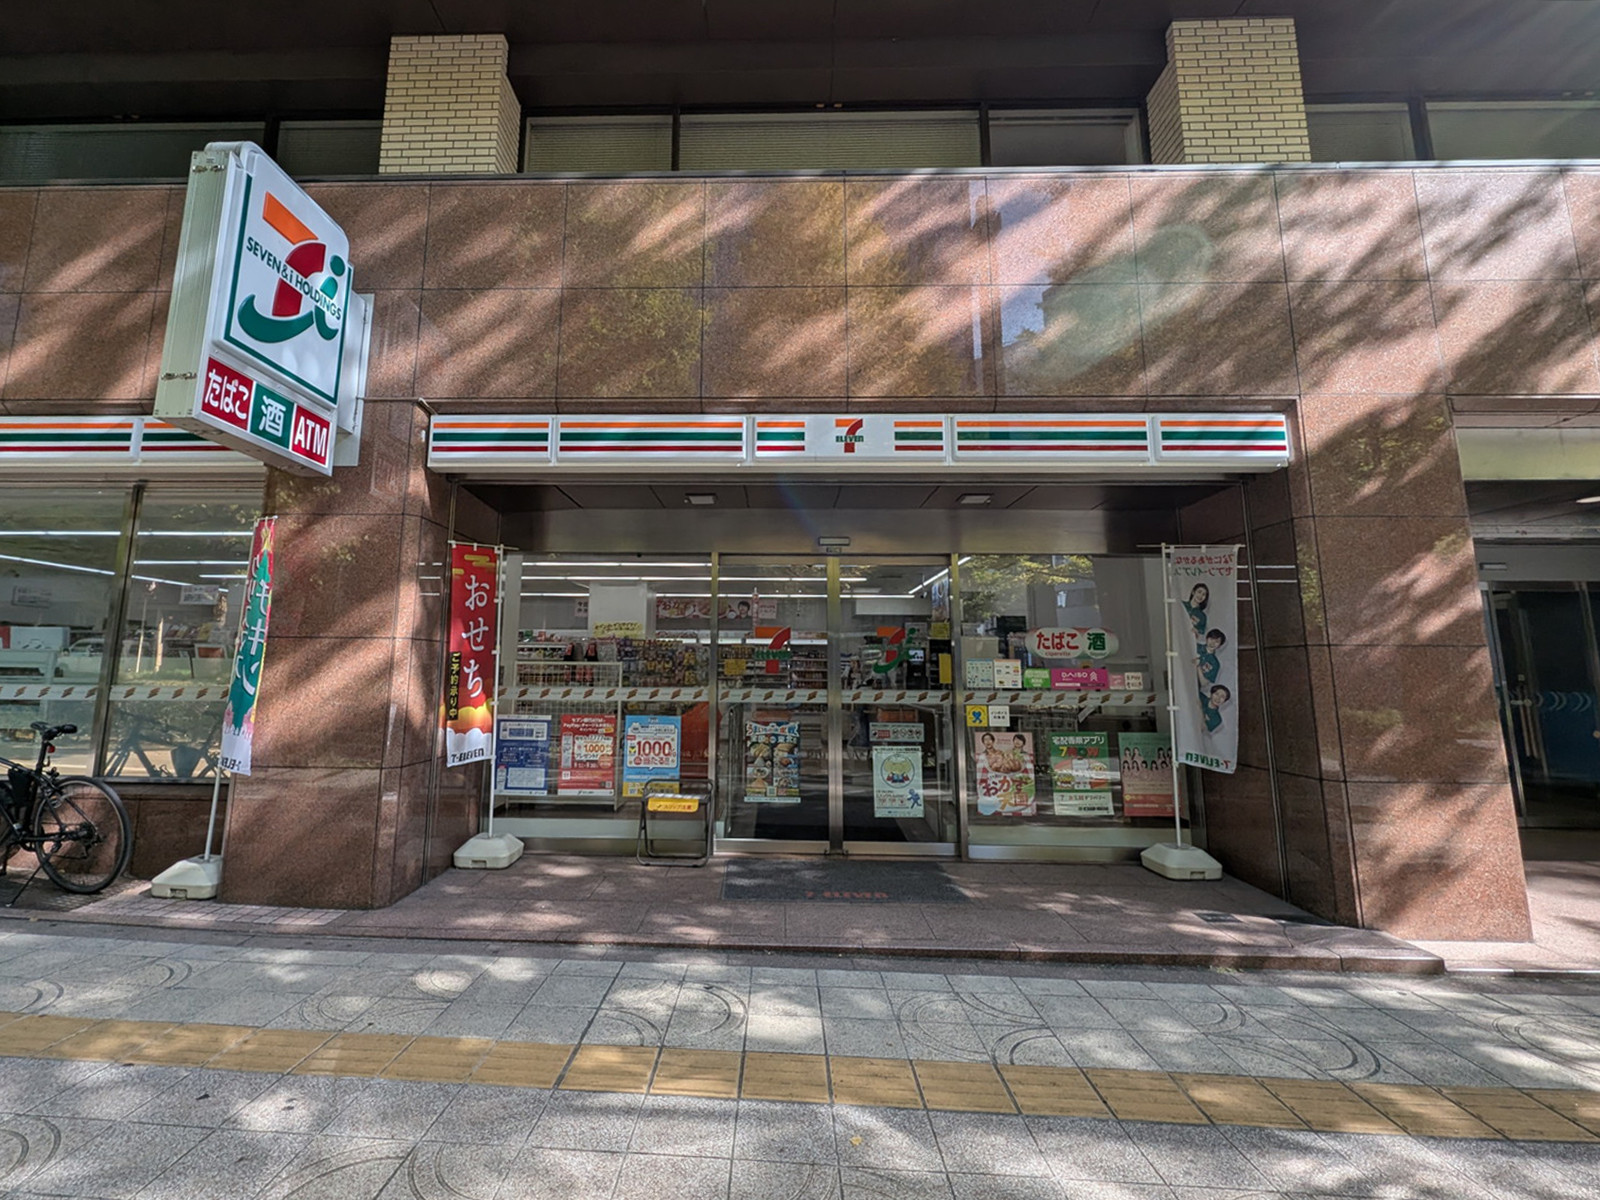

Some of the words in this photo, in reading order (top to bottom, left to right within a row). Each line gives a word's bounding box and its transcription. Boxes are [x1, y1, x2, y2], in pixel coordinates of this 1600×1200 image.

[295, 276, 342, 321] HOLDINGS
[205, 368, 249, 420] たばこ
[258, 395, 287, 437] 酒
[294, 415, 328, 457] ATM
[461, 574, 490, 698] おせち
[1036, 631, 1080, 650] たばこ
[1087, 632, 1106, 651] 酒
